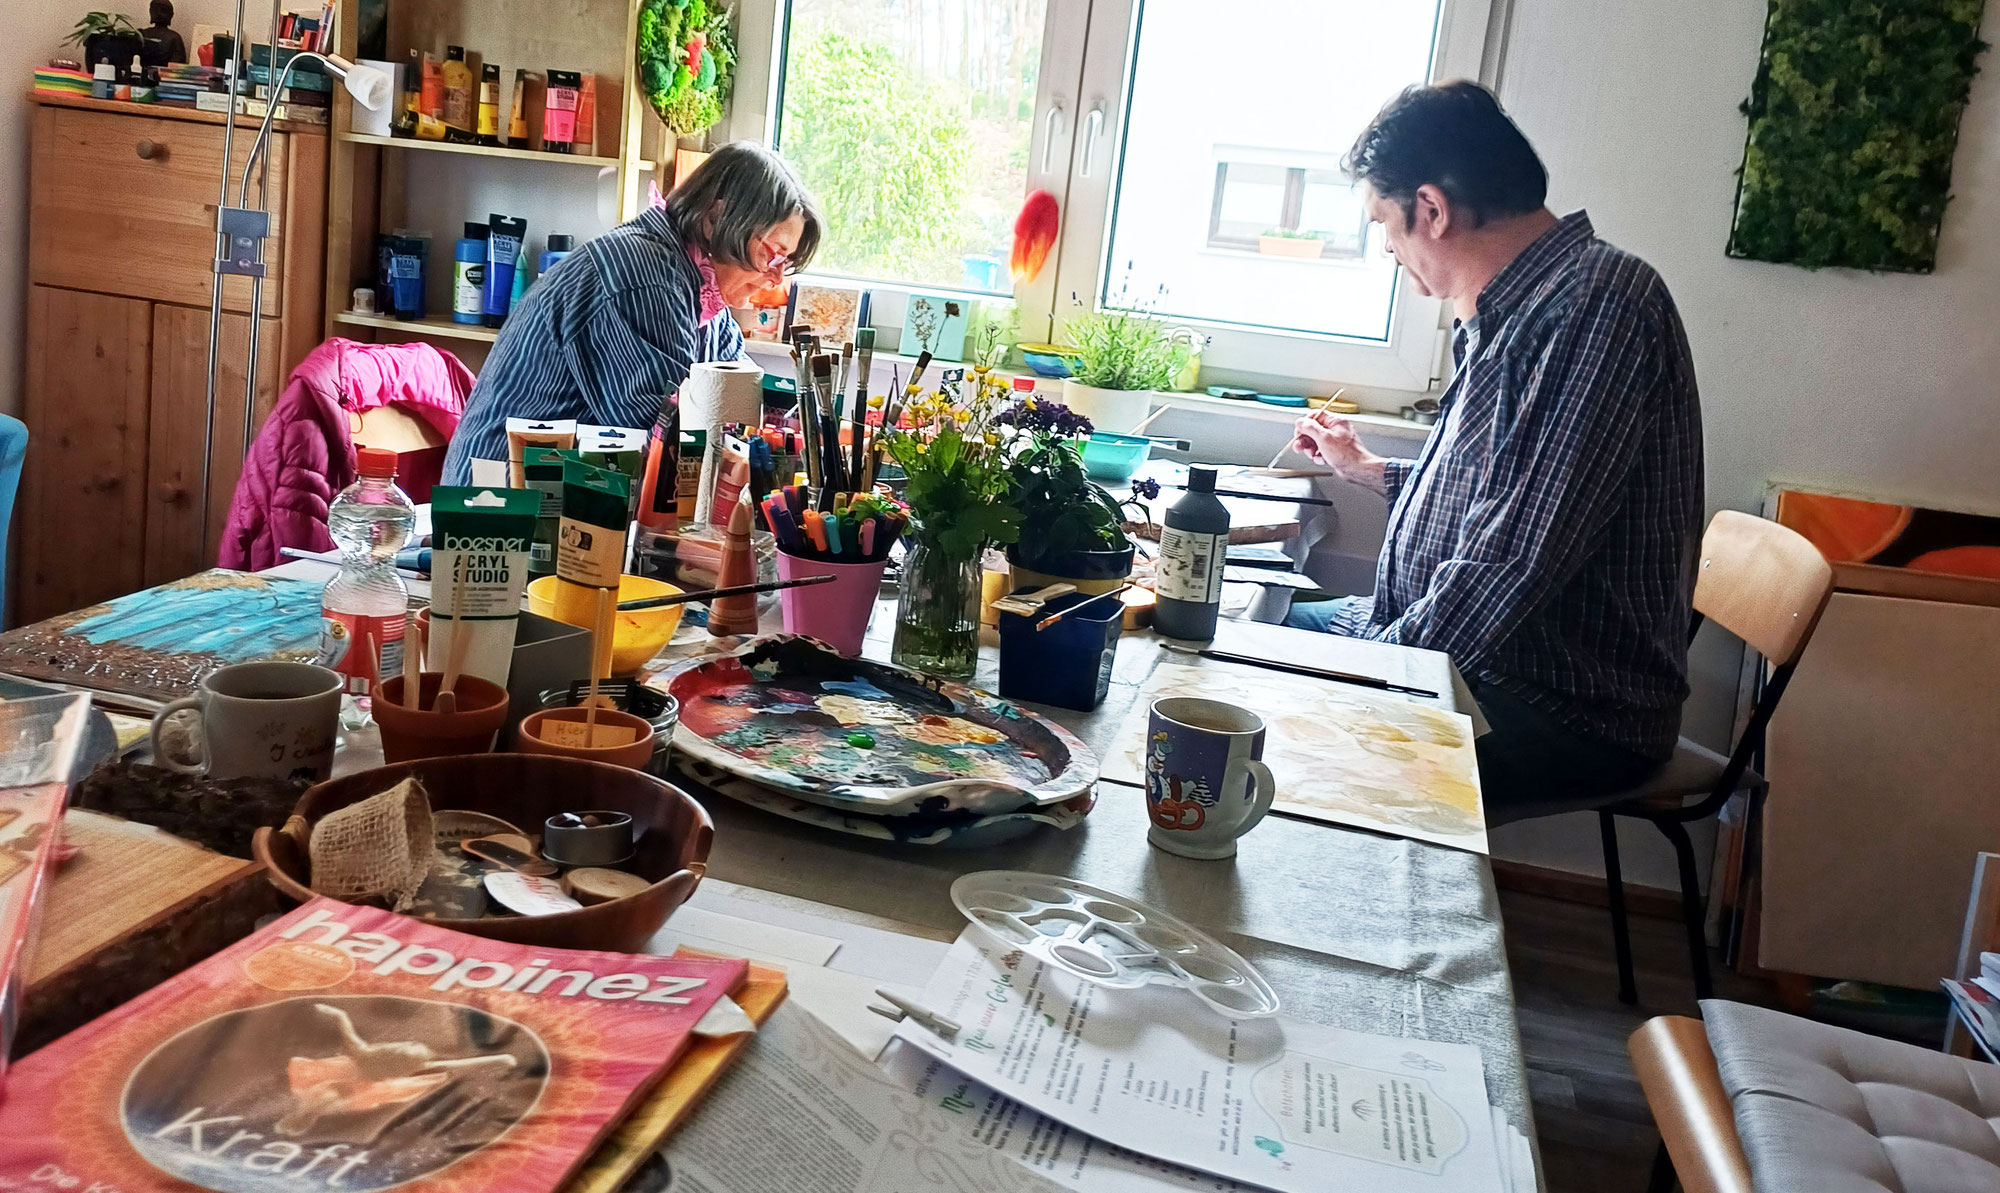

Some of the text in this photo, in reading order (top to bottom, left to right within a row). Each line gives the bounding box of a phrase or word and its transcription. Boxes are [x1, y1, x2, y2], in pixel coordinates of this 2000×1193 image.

[444, 532, 526, 553] boesner
[279, 909, 708, 1006] happinez
[963, 1028, 995, 1055] Mein
[153, 1106, 371, 1188] Kraft
